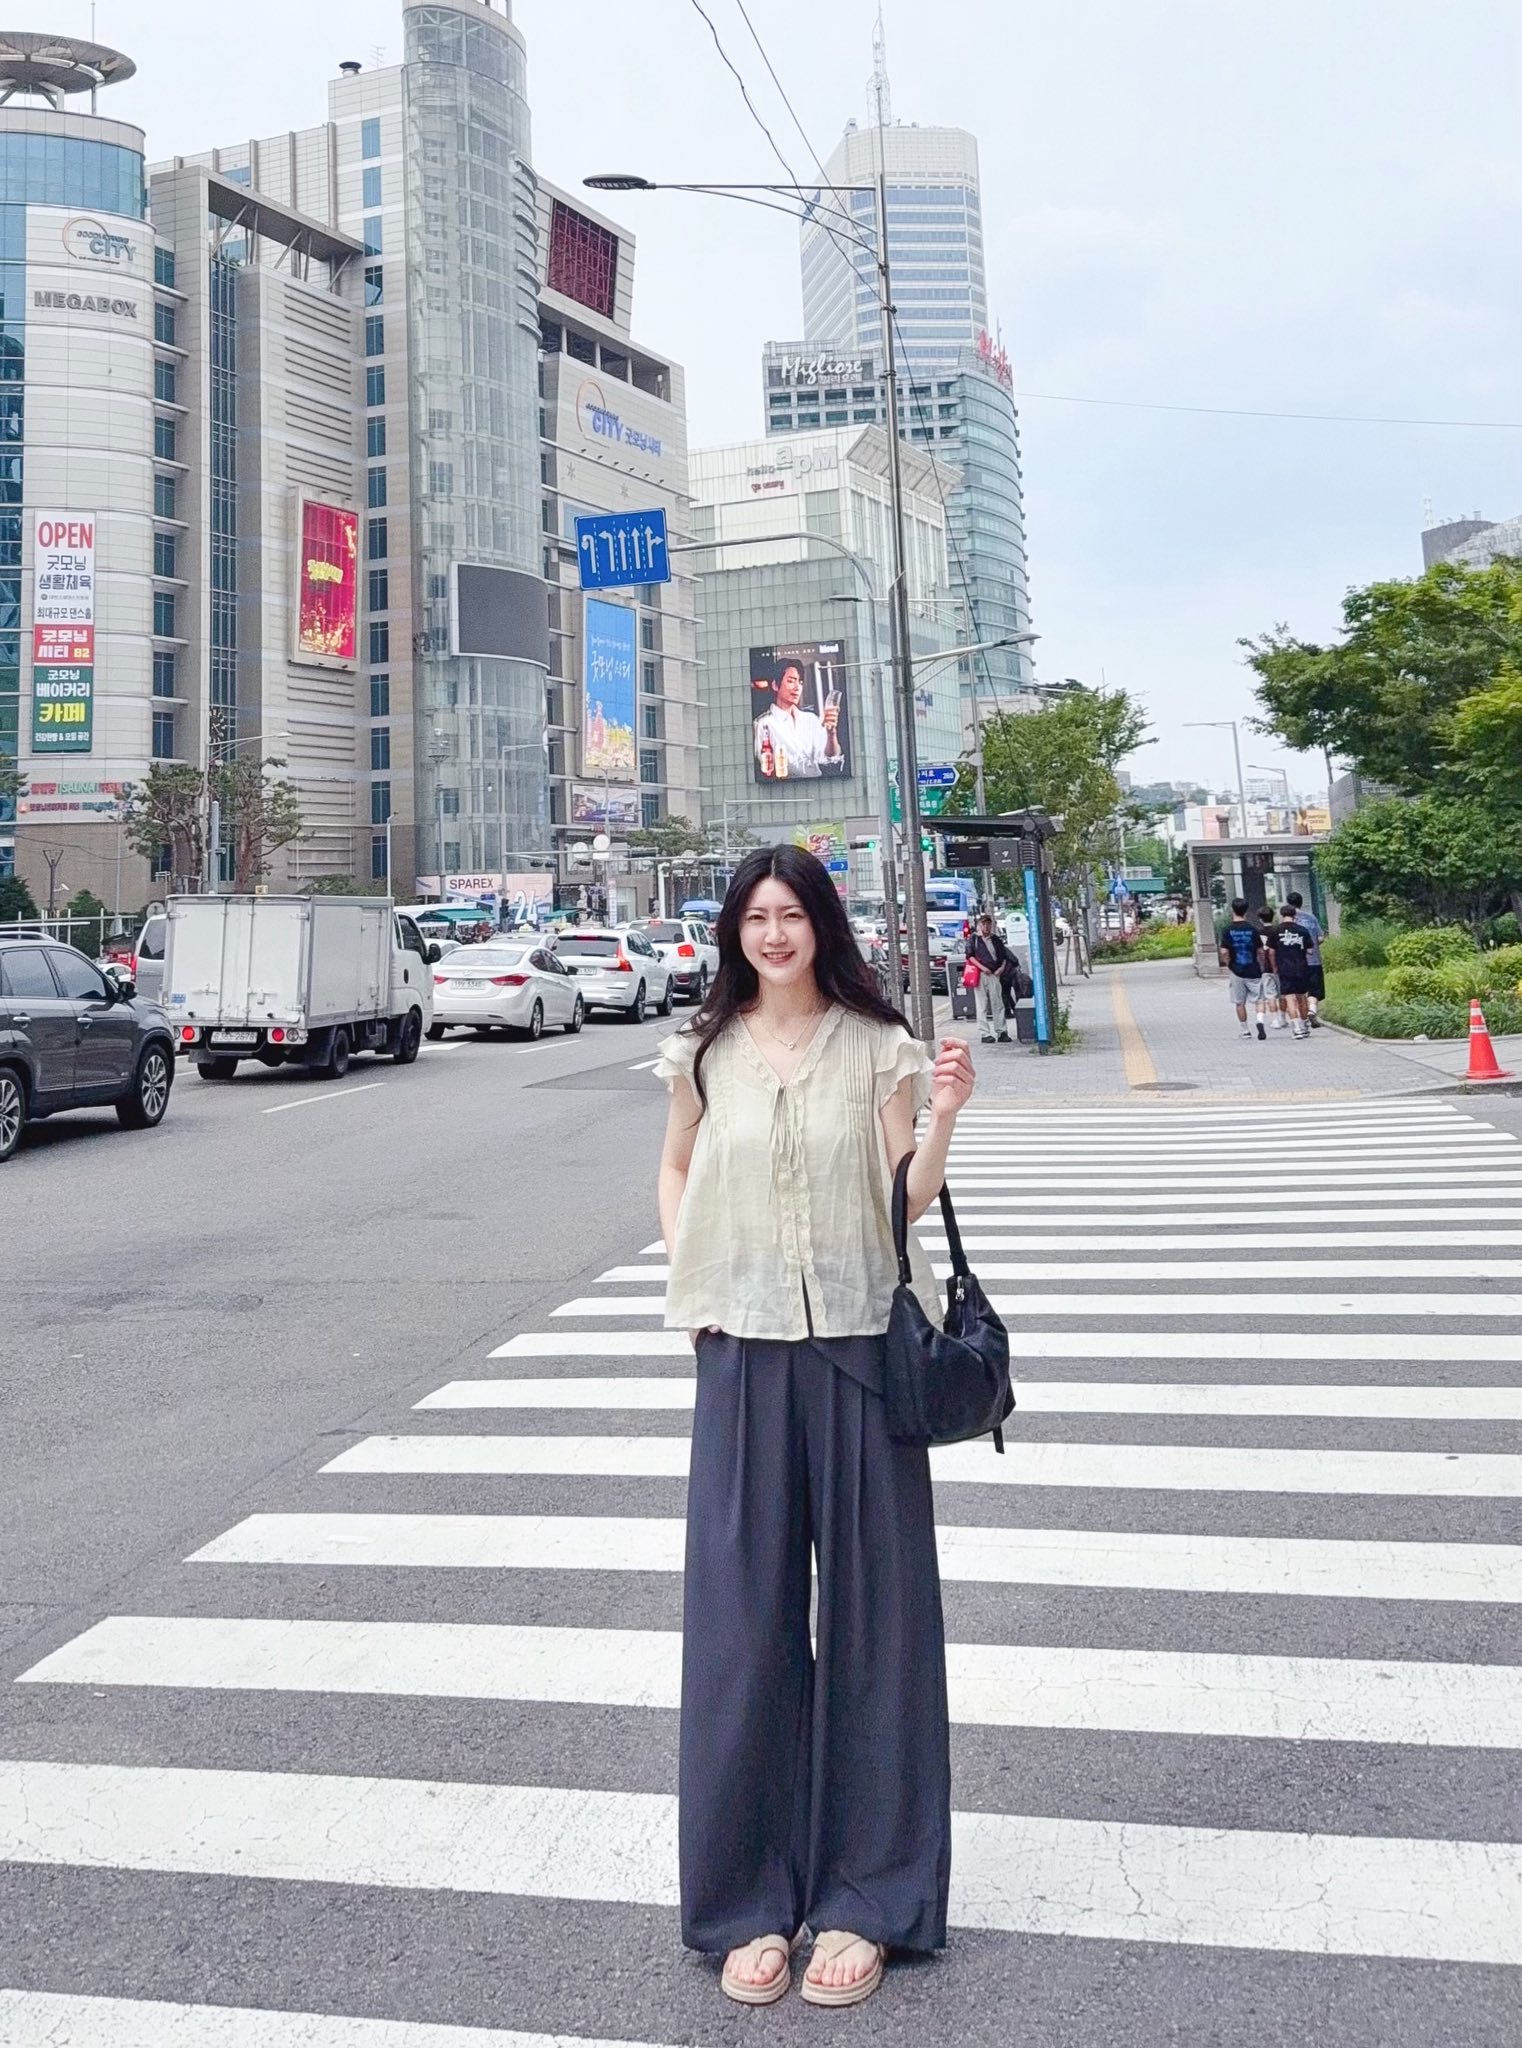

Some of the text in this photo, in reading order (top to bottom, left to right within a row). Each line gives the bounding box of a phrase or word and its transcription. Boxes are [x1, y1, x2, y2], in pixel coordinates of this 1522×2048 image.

[89, 239, 136, 261] CITY
[34, 291, 137, 318] MEGABOX
[781, 352, 863, 384] Migliore
[592, 411, 624, 441] CITY
[38, 521, 93, 549] OPEN
[47, 554, 86, 571] 굿모닝
[39, 574, 92, 591] 생활체육
[37, 606, 68, 619] 최대규모
[41, 629, 88, 643] 굿모닝
[37, 645, 91, 658] 시티 B2
[36, 683, 90, 697] 베이커리
[39, 703, 86, 722] 카페
[61, 782, 97, 794] SAUNA
[449, 878, 494, 890] SPAREX
[514, 889, 538, 925] 24
